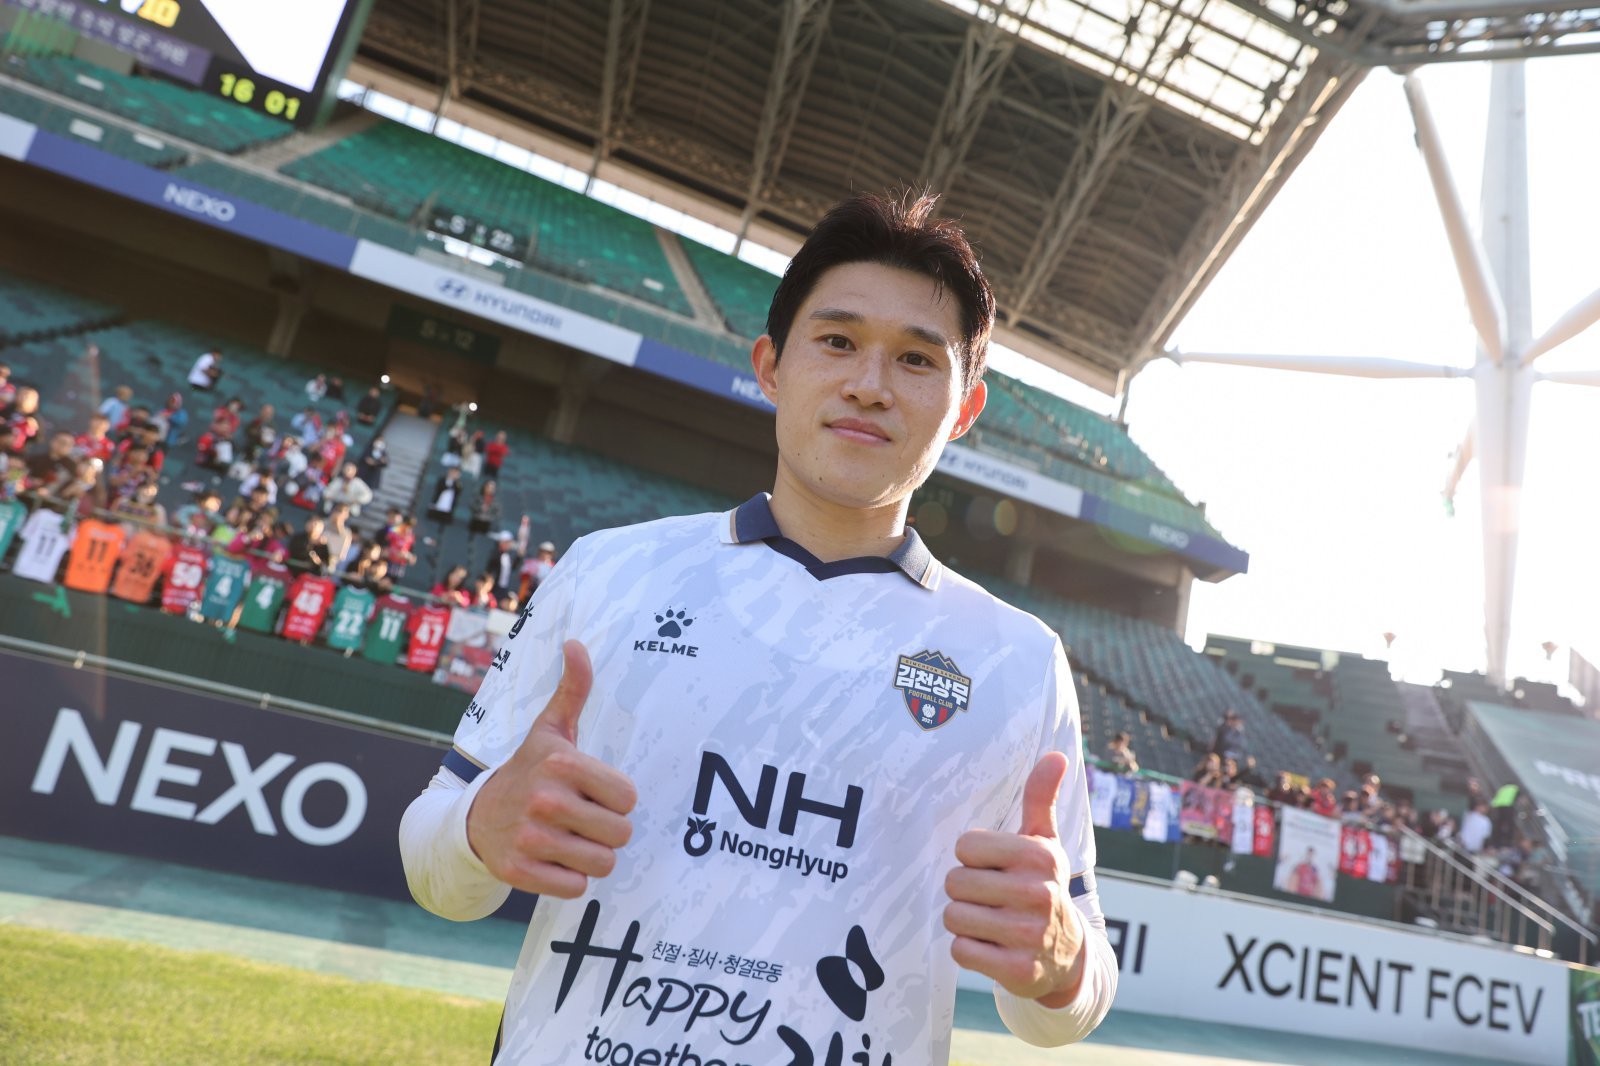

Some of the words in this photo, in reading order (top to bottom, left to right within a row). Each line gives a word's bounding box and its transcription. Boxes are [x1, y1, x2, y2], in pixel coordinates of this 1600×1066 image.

[163, 183, 236, 222] NEXO
[474, 288, 563, 331] HYUNDAI
[731, 376, 770, 404] NEX
[37, 534, 57, 556] 11
[1149, 521, 1190, 549] NEXO
[87, 538, 108, 563] 11
[214, 575, 233, 598] 4
[256, 584, 276, 610] 4
[335, 611, 363, 635] 22
[379, 615, 402, 642] 11
[415, 622, 445, 646] 47
[633, 640, 699, 658] KELME
[895, 664, 969, 706] 김천상무
[908, 689, 938, 703] FOOTBALL
[938, 698, 954, 709] CLUB
[30, 707, 368, 847] NEXO
[692, 750, 864, 849] NH
[719, 830, 848, 883] NongHyup
[550, 899, 772, 1045] Happy
[1217, 933, 1414, 1014] XCIENT
[1426, 969, 1546, 1035] FCEV
